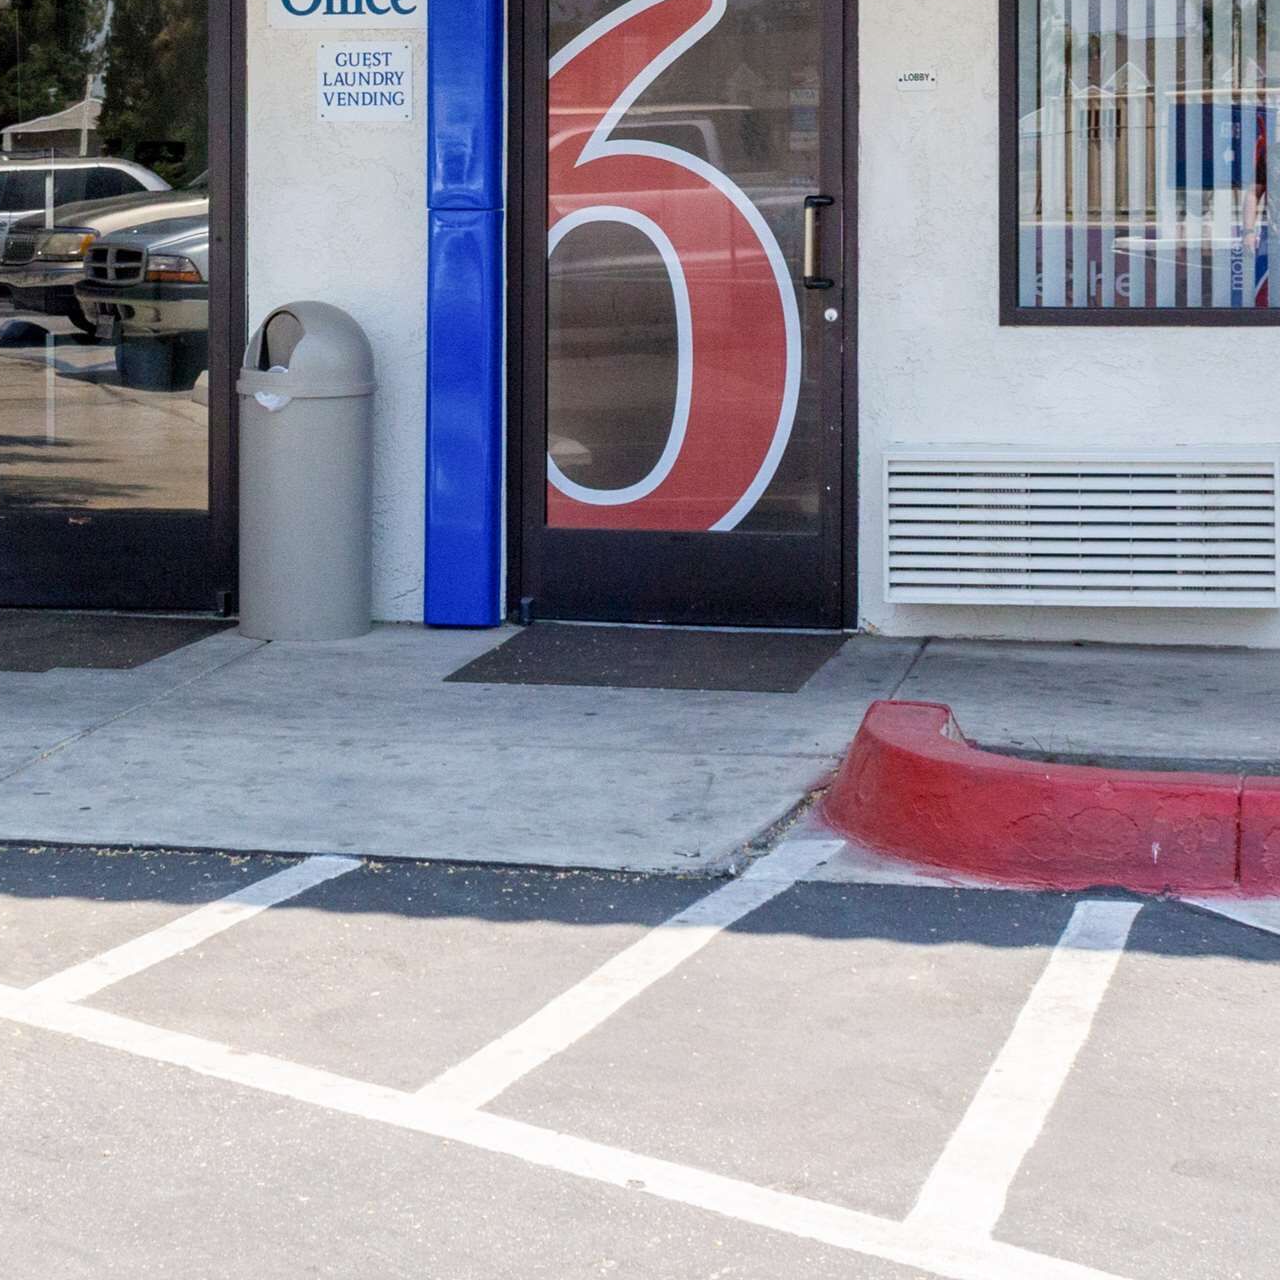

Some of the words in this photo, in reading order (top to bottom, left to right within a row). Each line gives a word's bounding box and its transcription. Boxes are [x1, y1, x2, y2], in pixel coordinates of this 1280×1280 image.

[335, 52, 392, 68] GUEST
[323, 71, 405, 87] LAUNDRY
[903, 72, 930, 81] LOBBY
[323, 91, 405, 106] VENDING
